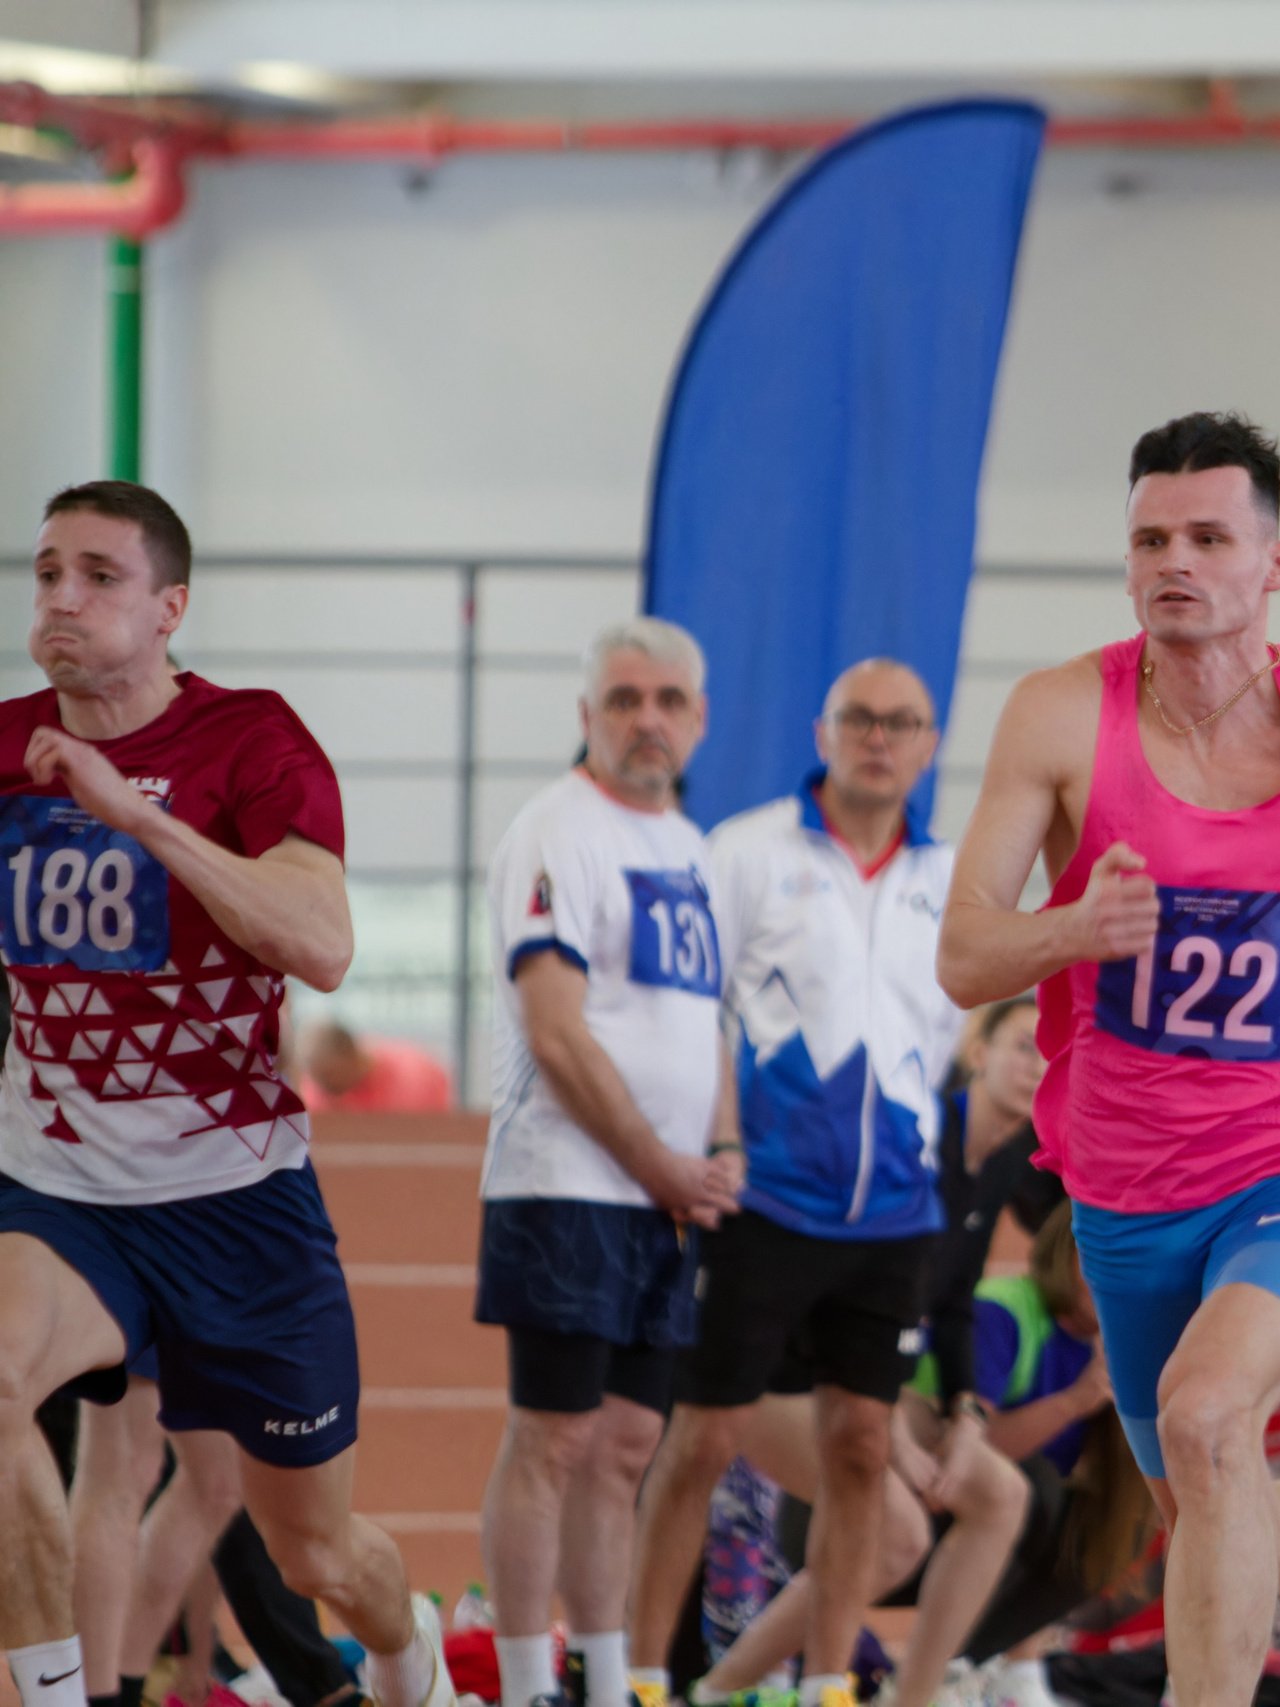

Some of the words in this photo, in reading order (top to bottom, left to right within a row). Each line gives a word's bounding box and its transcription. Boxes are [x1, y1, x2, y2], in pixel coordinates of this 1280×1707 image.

[8, 845, 136, 952] 188
[648, 900, 717, 986] 131
[1131, 935, 1278, 1043] 122
[264, 1404, 340, 1436] KELME
